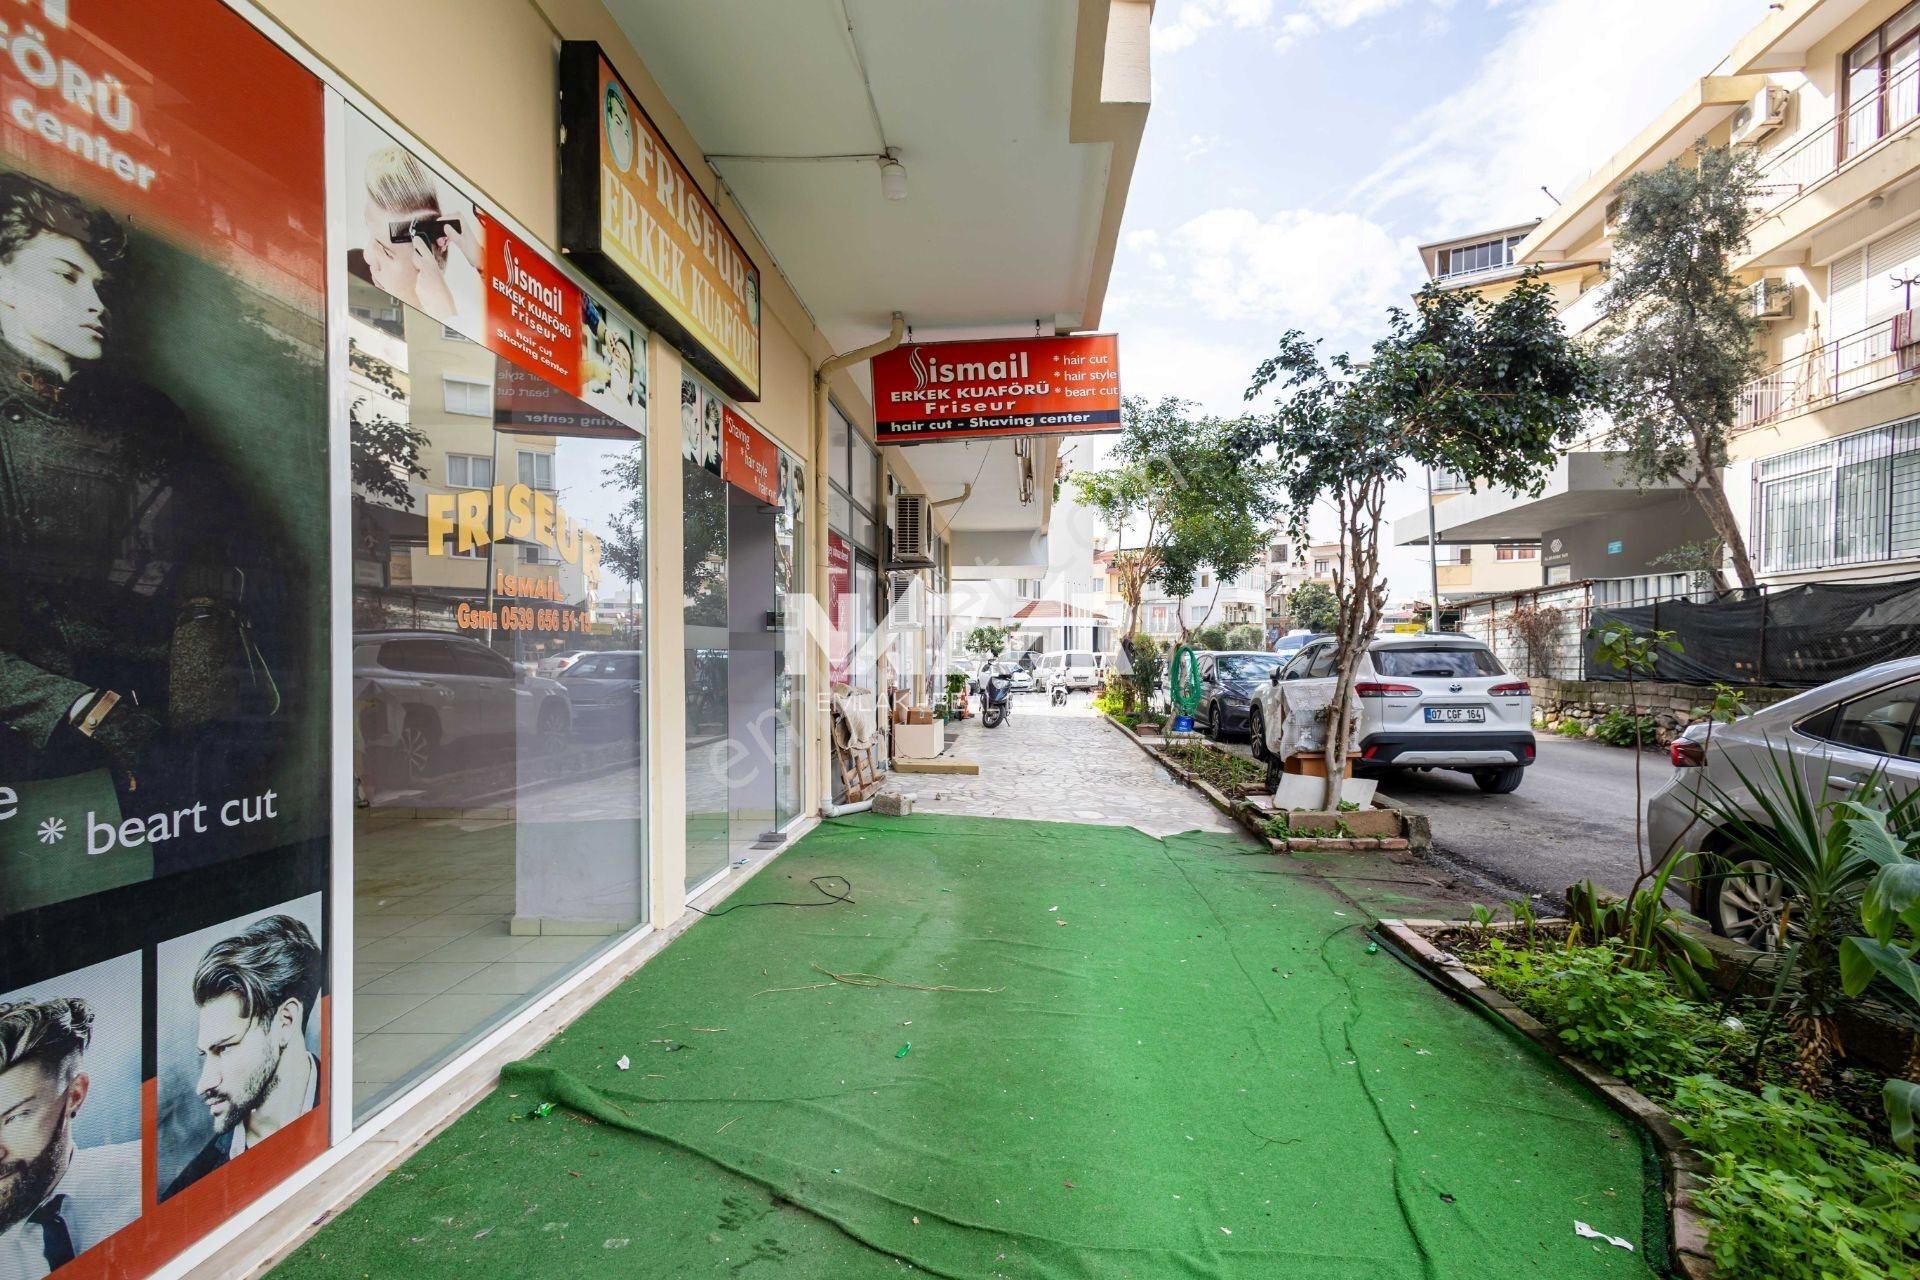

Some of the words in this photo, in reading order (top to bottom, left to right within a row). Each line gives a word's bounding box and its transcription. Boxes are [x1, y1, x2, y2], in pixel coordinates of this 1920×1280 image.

[9, 98, 156, 190] center
[635, 117, 746, 305] FRISEUR
[601, 163, 686, 301] ERKEK
[690, 262, 760, 380] KUAFÖRÜ
[492, 276, 525, 307] ERKEK
[528, 301, 572, 338] KUAFÖRÜ
[511, 304, 557, 343] Friseur
[496, 328, 538, 360] Shaving
[540, 357, 569, 377] center
[515, 329, 537, 347] hair
[539, 344, 553, 358] cut
[1063, 355, 1087, 365] hair
[1089, 354, 1108, 364] cut
[1064, 371, 1087, 381] hair
[1090, 370, 1117, 381] style
[891, 389, 951, 402] ERKEK
[957, 381, 1050, 399] KUAFÖRÜ
[1065, 387, 1097, 397] beart
[1100, 386, 1119, 396] cut
[891, 421, 924, 432] hair
[930, 419, 953, 430] cut
[969, 416, 1035, 428] Shaving
[1040, 413, 1091, 424] center
[925, 401, 1016, 415] Friseur
[427, 483, 601, 583] FRISEUR
[457, 602, 497, 630] Gsm:
[501, 605, 534, 631] 0539
[537, 608, 560, 632] 656
[1431, 709, 1442, 719] 07
[1446, 709, 1463, 719] CGF
[1467, 709, 1482, 719] 164
[87, 801, 208, 855] beart
[220, 788, 278, 827] cut
